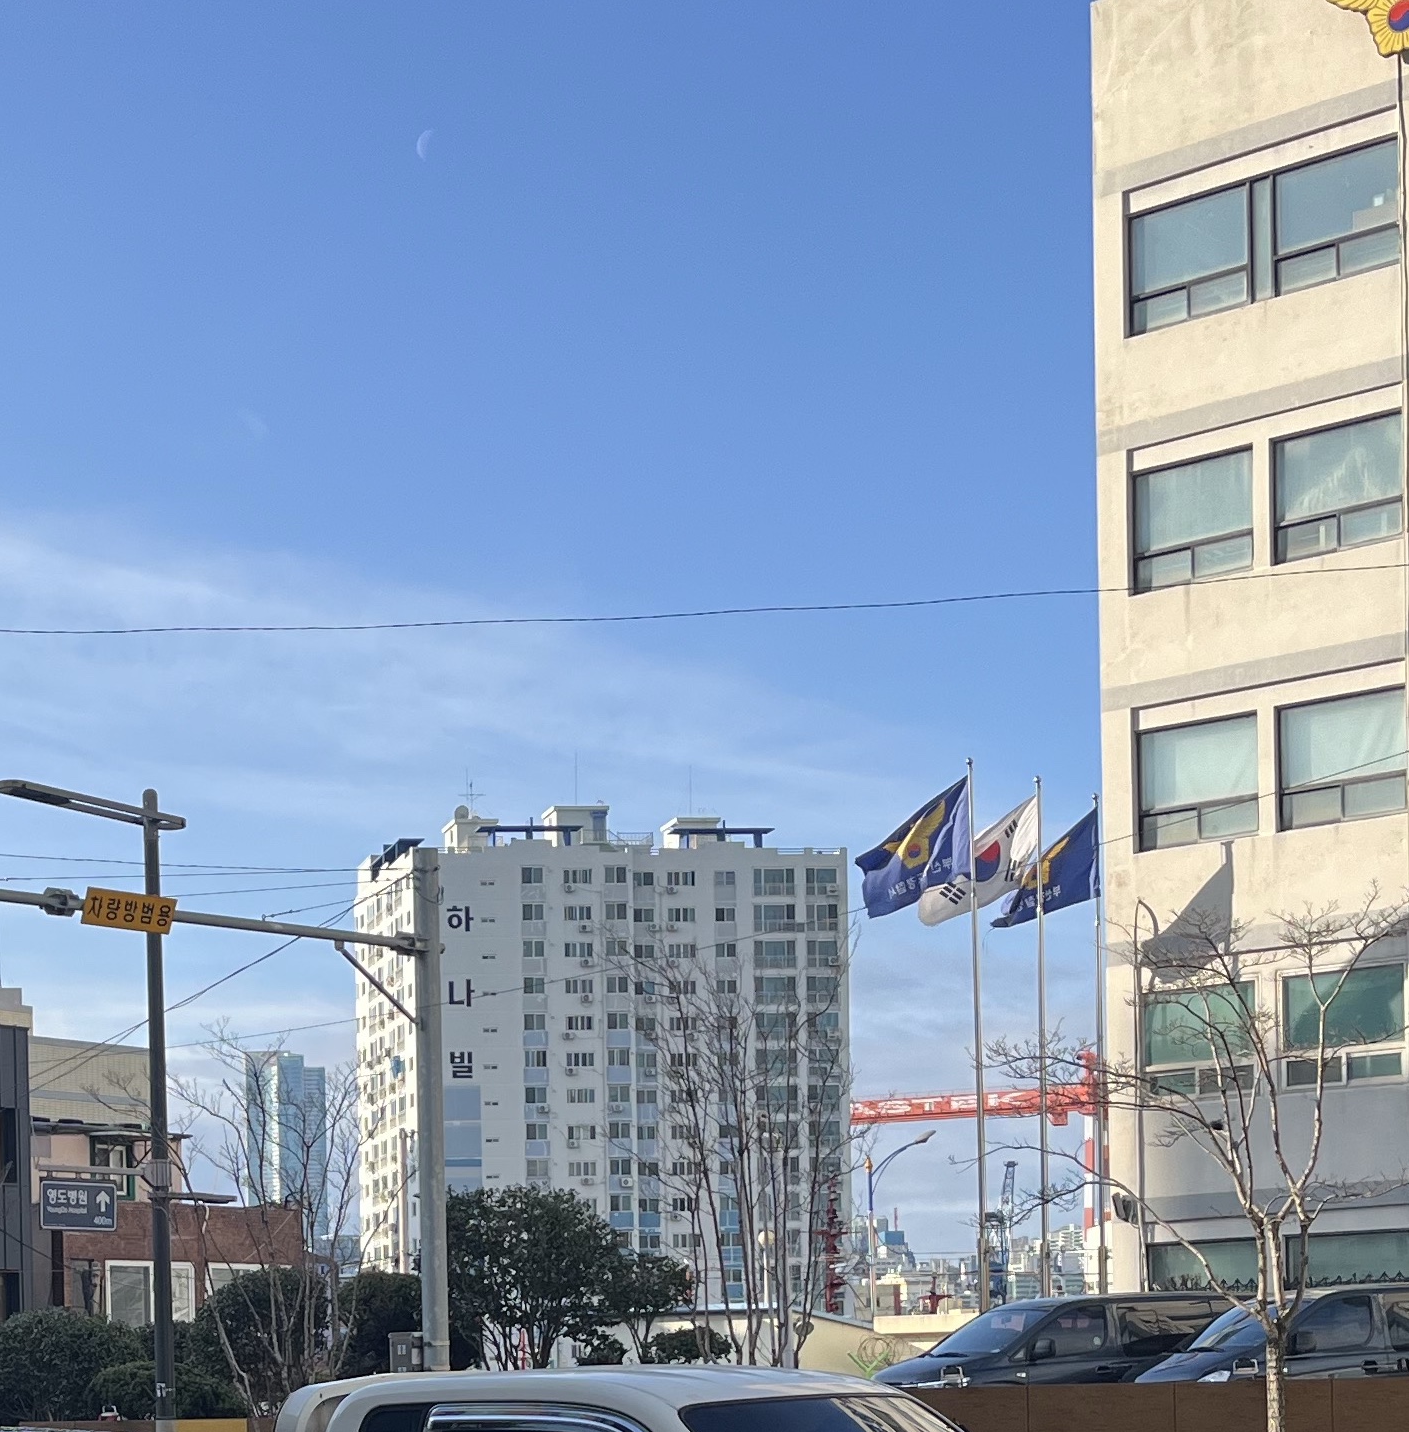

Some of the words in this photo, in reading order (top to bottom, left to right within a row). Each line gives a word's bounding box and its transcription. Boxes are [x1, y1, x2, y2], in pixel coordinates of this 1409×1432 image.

[87, 895, 171, 927] 차량방범용
[446, 904, 475, 1080] 하나빌
[46, 1188, 88, 1205] 영도병원
